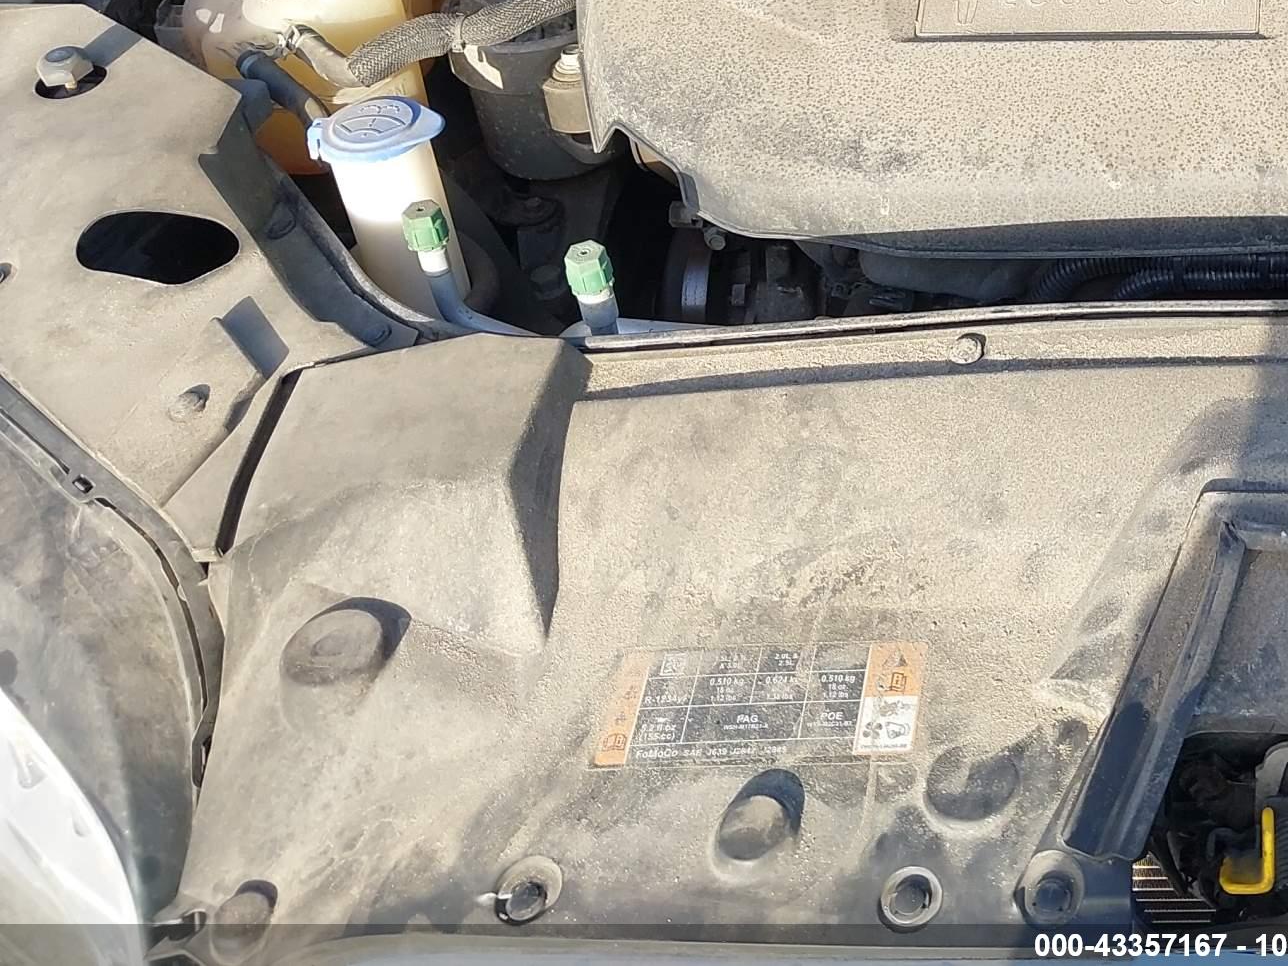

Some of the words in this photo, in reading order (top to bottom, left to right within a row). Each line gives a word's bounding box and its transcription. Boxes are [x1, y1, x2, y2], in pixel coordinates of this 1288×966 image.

[821, 674, 844, 683] 0.510
[844, 674, 856, 684] kg
[736, 714, 759, 723] PAG
[819, 711, 844, 721] POE
